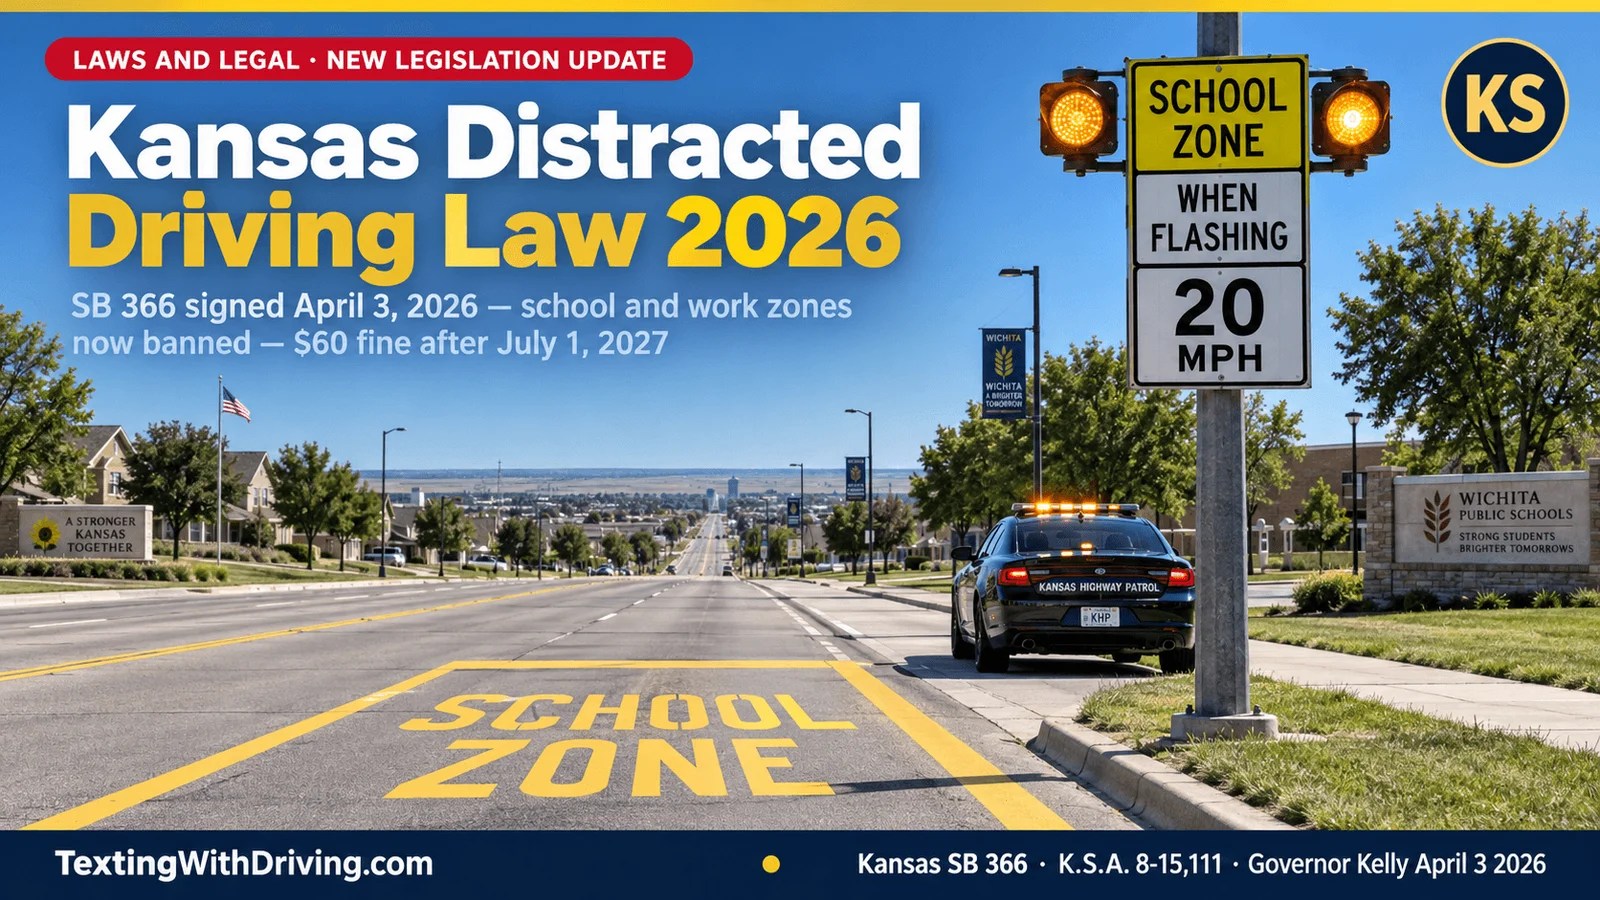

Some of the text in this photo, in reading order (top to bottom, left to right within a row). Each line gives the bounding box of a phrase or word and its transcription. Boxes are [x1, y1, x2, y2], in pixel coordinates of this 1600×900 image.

[1149, 77, 1288, 115] SCHOOL
[1173, 123, 1264, 159] ZONE
[1177, 182, 1257, 213] WHEN
[1151, 220, 1288, 252] FLASHING
[1175, 277, 1265, 337] 20
[986, 334, 1021, 342] WICHITA
[1178, 343, 1262, 373] MPH
[985, 382, 1022, 391] WICHITA
[1459, 490, 1541, 506] WICHITA
[1459, 508, 1574, 521] PUBLIC SCHOOLS
[65, 516, 136, 527] A STRONGER
[75, 529, 126, 540] KANSAS
[1459, 531, 1556, 541] STRONG STUDENTS
[67, 542, 133, 553] TOGETHER
[1459, 544, 1574, 553] BRIGHTER TOMORROWS
[1039, 582, 1160, 592] KANSAS HIGHWAY PATROL
[1091, 612, 1111, 623] KHP
[397, 693, 859, 731] SCHOOL
[383, 738, 836, 799] ZONE
